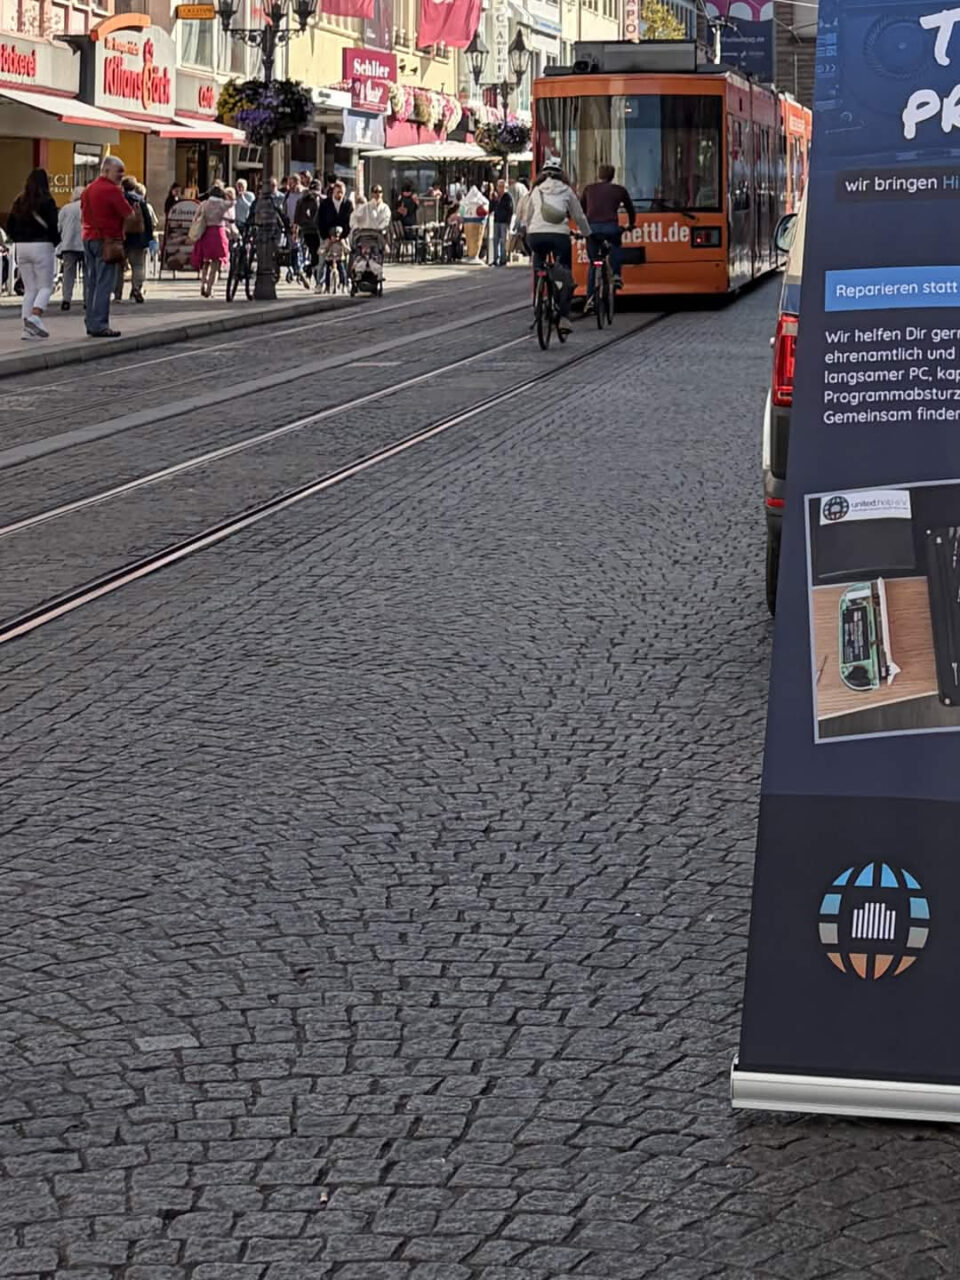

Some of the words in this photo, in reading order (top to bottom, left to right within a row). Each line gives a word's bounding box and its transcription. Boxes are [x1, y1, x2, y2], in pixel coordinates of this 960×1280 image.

[353, 58, 390, 78] Schlier
[846, 177, 870, 191] wir
[874, 175, 938, 195] bringen
[837, 284, 918, 298] Reparieren
[923, 282, 957, 293] statt
[826, 331, 850, 343] Wir
[855, 328, 900, 341] helfen
[906, 327, 926, 340] Dir
[825, 347, 922, 363] ehrenamtlich
[928, 346, 955, 359] und
[825, 370, 904, 385] langsamer
[910, 367, 932, 381] PC,
[825, 387, 960, 405] Programmabsturz
[824, 410, 911, 424] Gemeinsam
